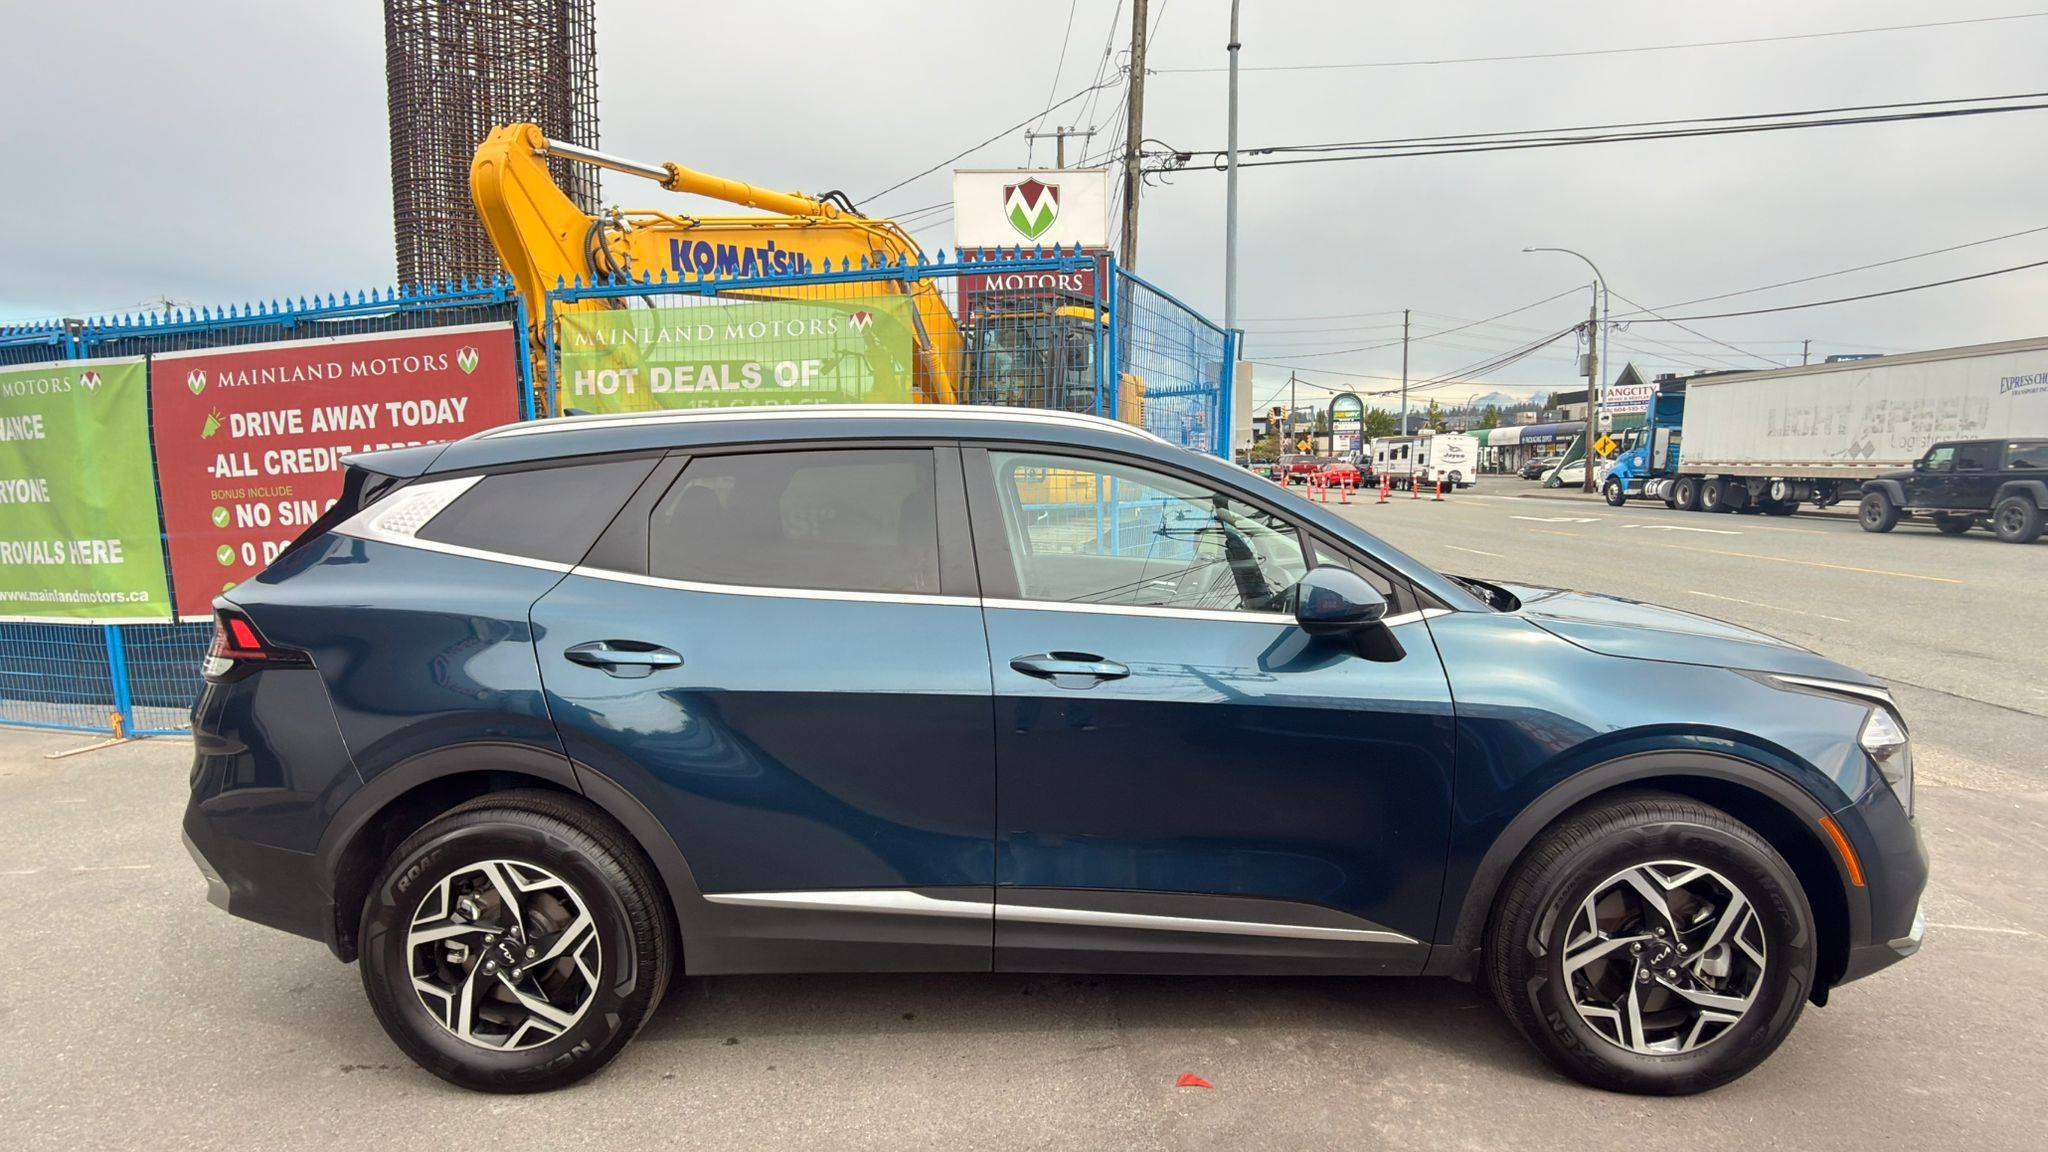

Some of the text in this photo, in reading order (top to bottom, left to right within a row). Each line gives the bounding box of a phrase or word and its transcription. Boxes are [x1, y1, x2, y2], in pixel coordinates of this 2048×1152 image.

[669, 238, 804, 277] KOMATSU
[985, 274, 1084, 292] MOTORS
[575, 318, 840, 346] MAINLAND MOTORS
[218, 353, 449, 388] MAINLAND MOTORS
[575, 360, 823, 395] HOT DEALS OF
[1999, 374, 2034, 395] EXPRESS
[2, 376, 72, 397] MOTORS
[229, 396, 468, 438] DRIVE AWAY TODAY
[211, 485, 293, 501] BONUS INCLUDE
[235, 502, 273, 529] NO
[278, 499, 318, 526] SIN
[69, 538, 124, 565] HERE
